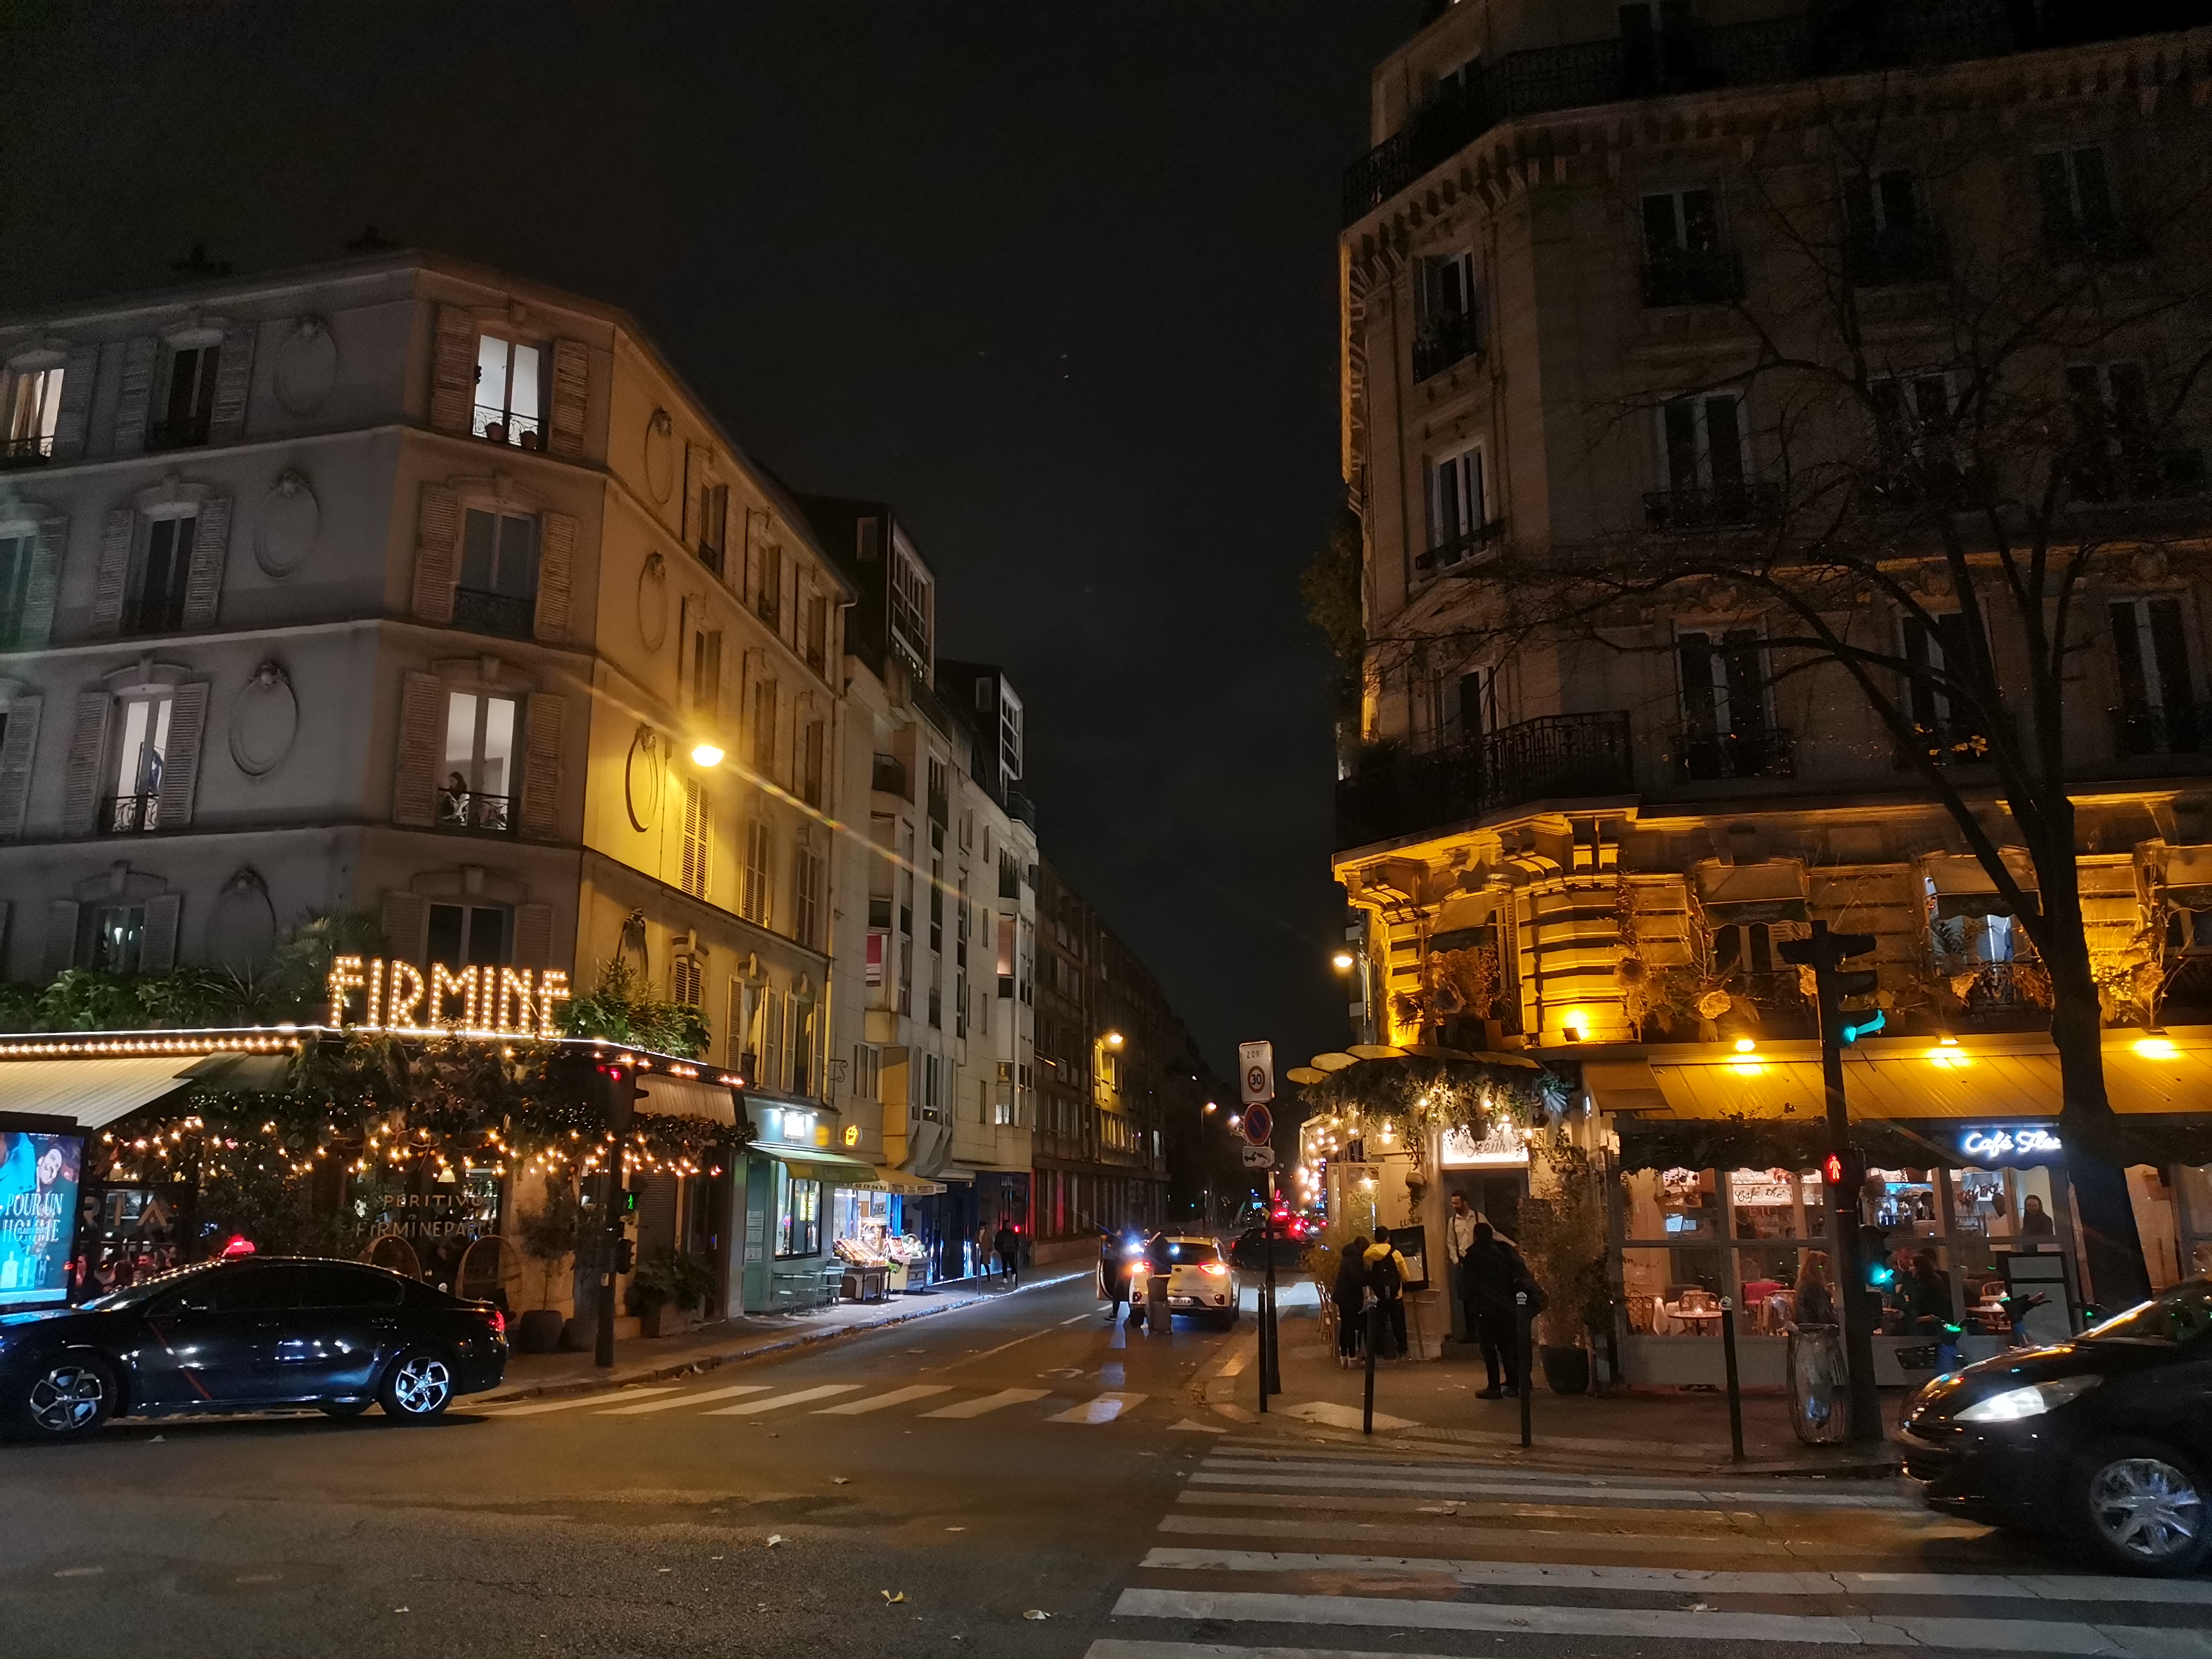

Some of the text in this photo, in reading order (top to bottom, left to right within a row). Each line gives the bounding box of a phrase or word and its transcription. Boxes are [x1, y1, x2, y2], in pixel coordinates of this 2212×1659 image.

[329, 956, 570, 1037] FIRMINE
[1251, 1073, 1261, 1085] 30
[1965, 1131, 2015, 1157] Café
[5, 1192, 64, 1217] POUR UN
[1735, 1186, 1760, 1203] Café
